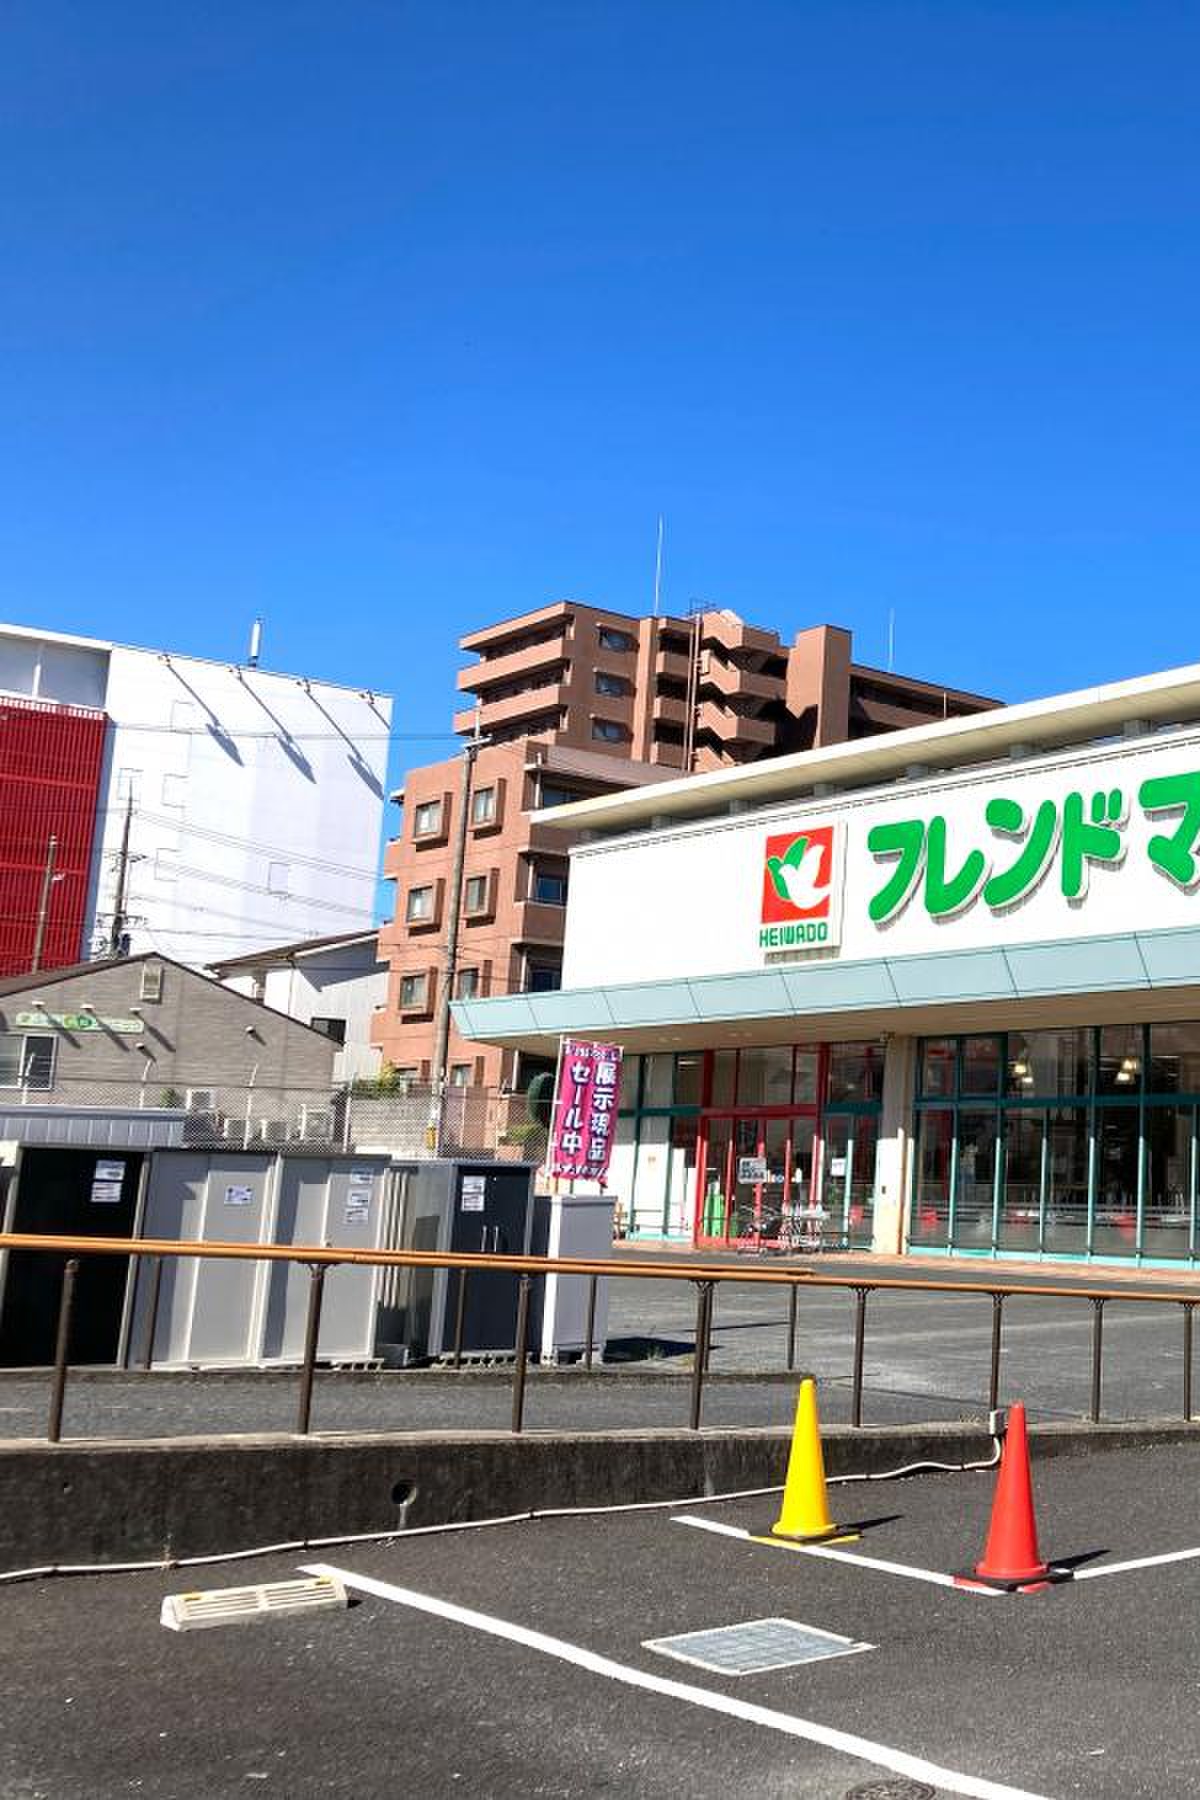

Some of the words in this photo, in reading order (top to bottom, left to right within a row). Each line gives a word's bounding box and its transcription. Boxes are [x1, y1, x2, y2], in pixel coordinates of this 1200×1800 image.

[759, 922, 828, 948] HEIWADO
[560, 1060, 591, 1156] セール中
